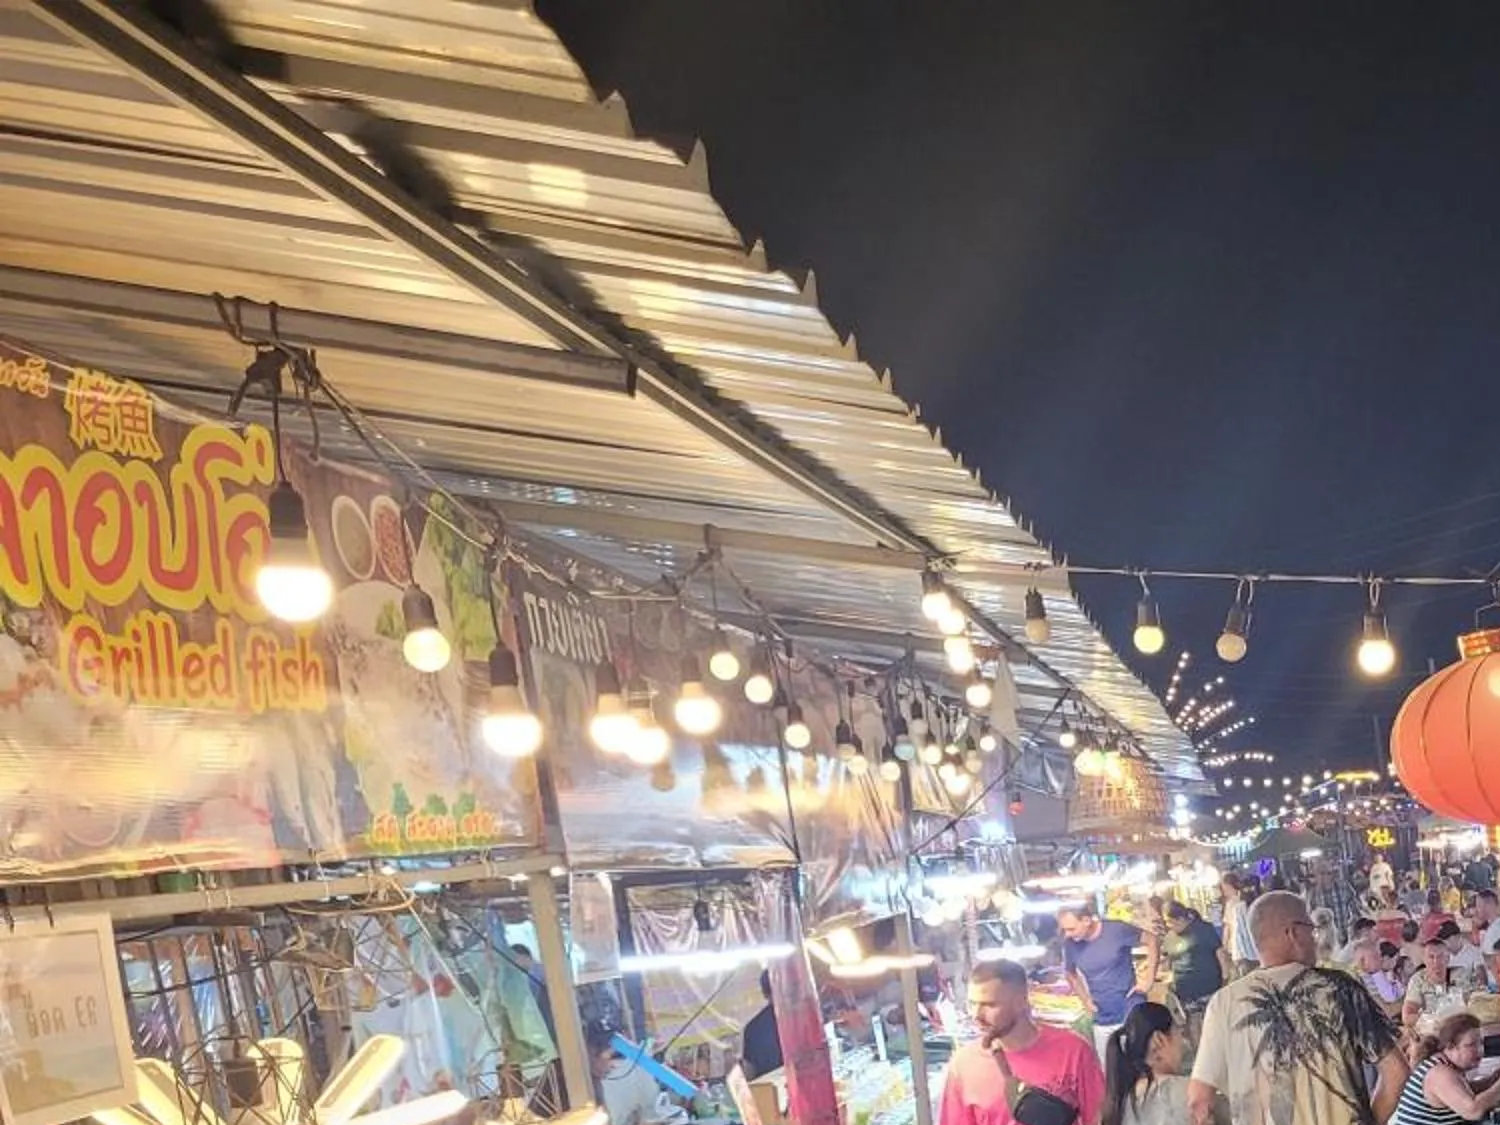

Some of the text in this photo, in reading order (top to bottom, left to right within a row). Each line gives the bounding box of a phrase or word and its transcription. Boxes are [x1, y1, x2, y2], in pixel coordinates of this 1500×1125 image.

[67, 370, 162, 459] 烤魚
[64, 613, 325, 709] Grilled fish
